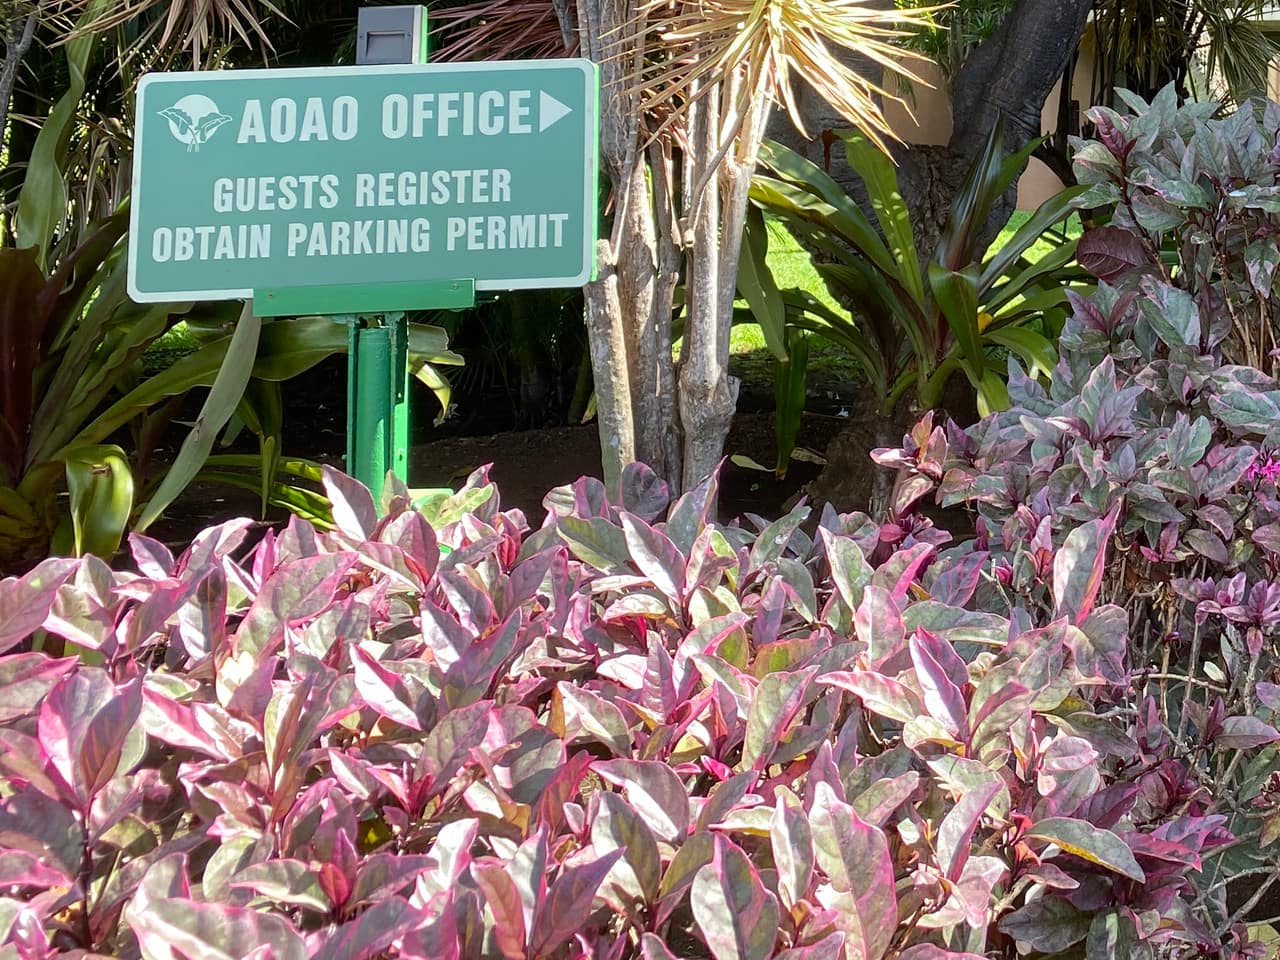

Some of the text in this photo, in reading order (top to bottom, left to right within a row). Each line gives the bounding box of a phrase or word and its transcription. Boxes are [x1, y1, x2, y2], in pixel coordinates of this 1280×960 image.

[237, 90, 531, 143] AOAO OFFICE
[214, 169, 511, 212] GUESTS REGISTER
[153, 214, 568, 262] OBTAIN PARKING PERMIT
